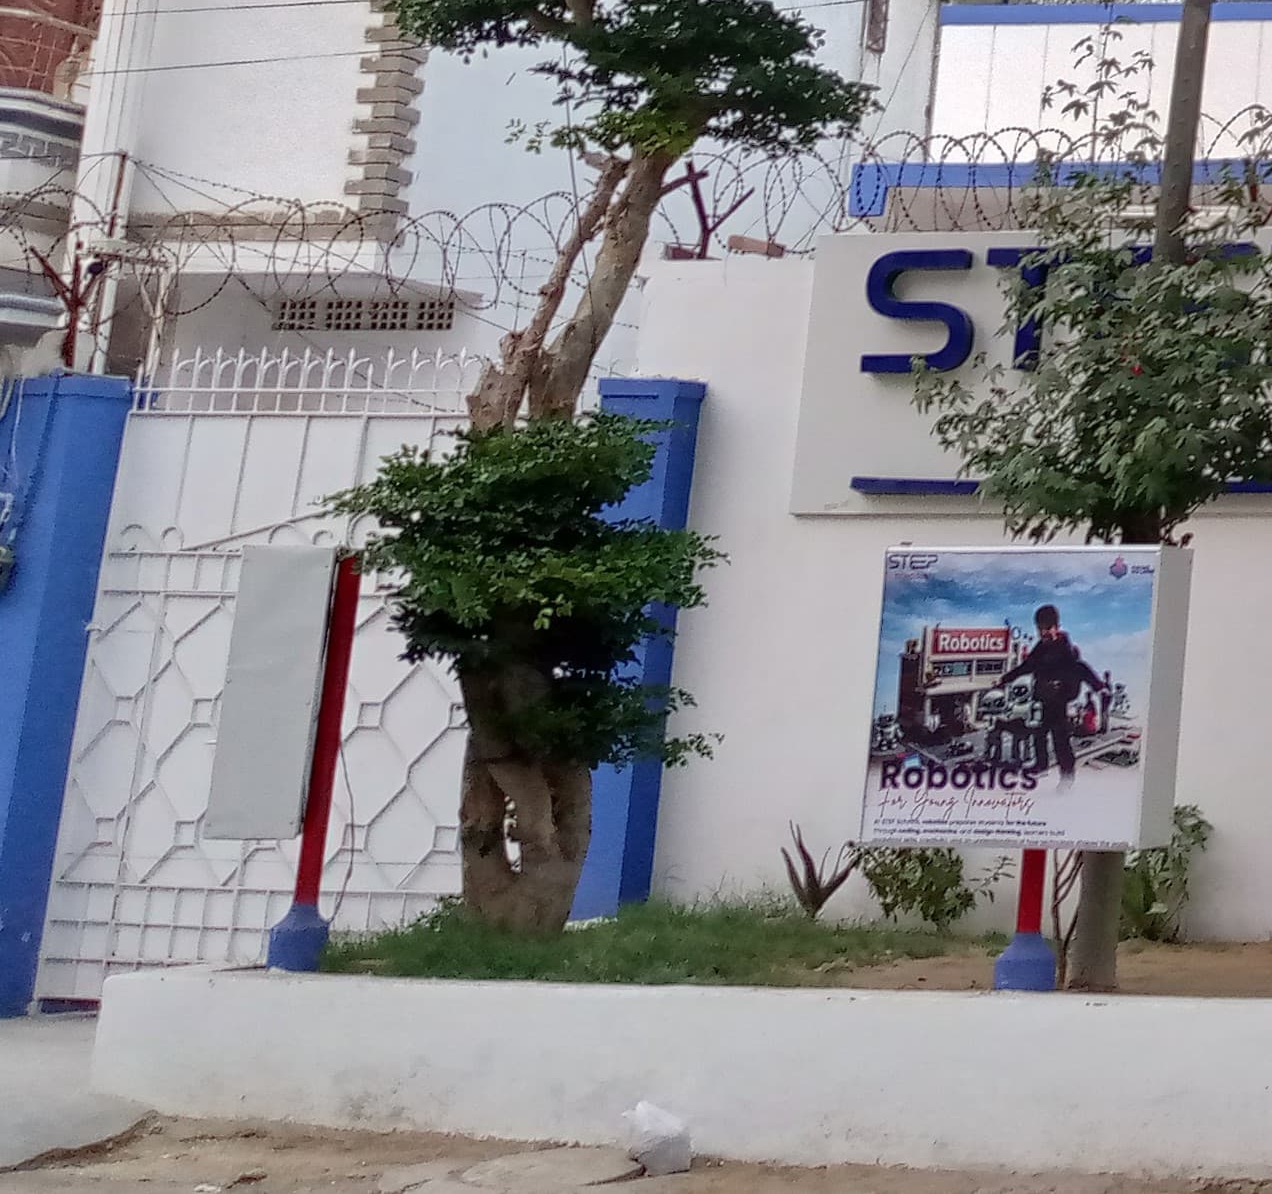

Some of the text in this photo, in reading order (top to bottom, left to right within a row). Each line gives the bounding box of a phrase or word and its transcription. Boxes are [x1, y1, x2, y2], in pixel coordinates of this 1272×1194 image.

[888, 554, 940, 570] STEP
[939, 632, 1004, 653] Robotics
[879, 759, 1038, 790] Robotics
